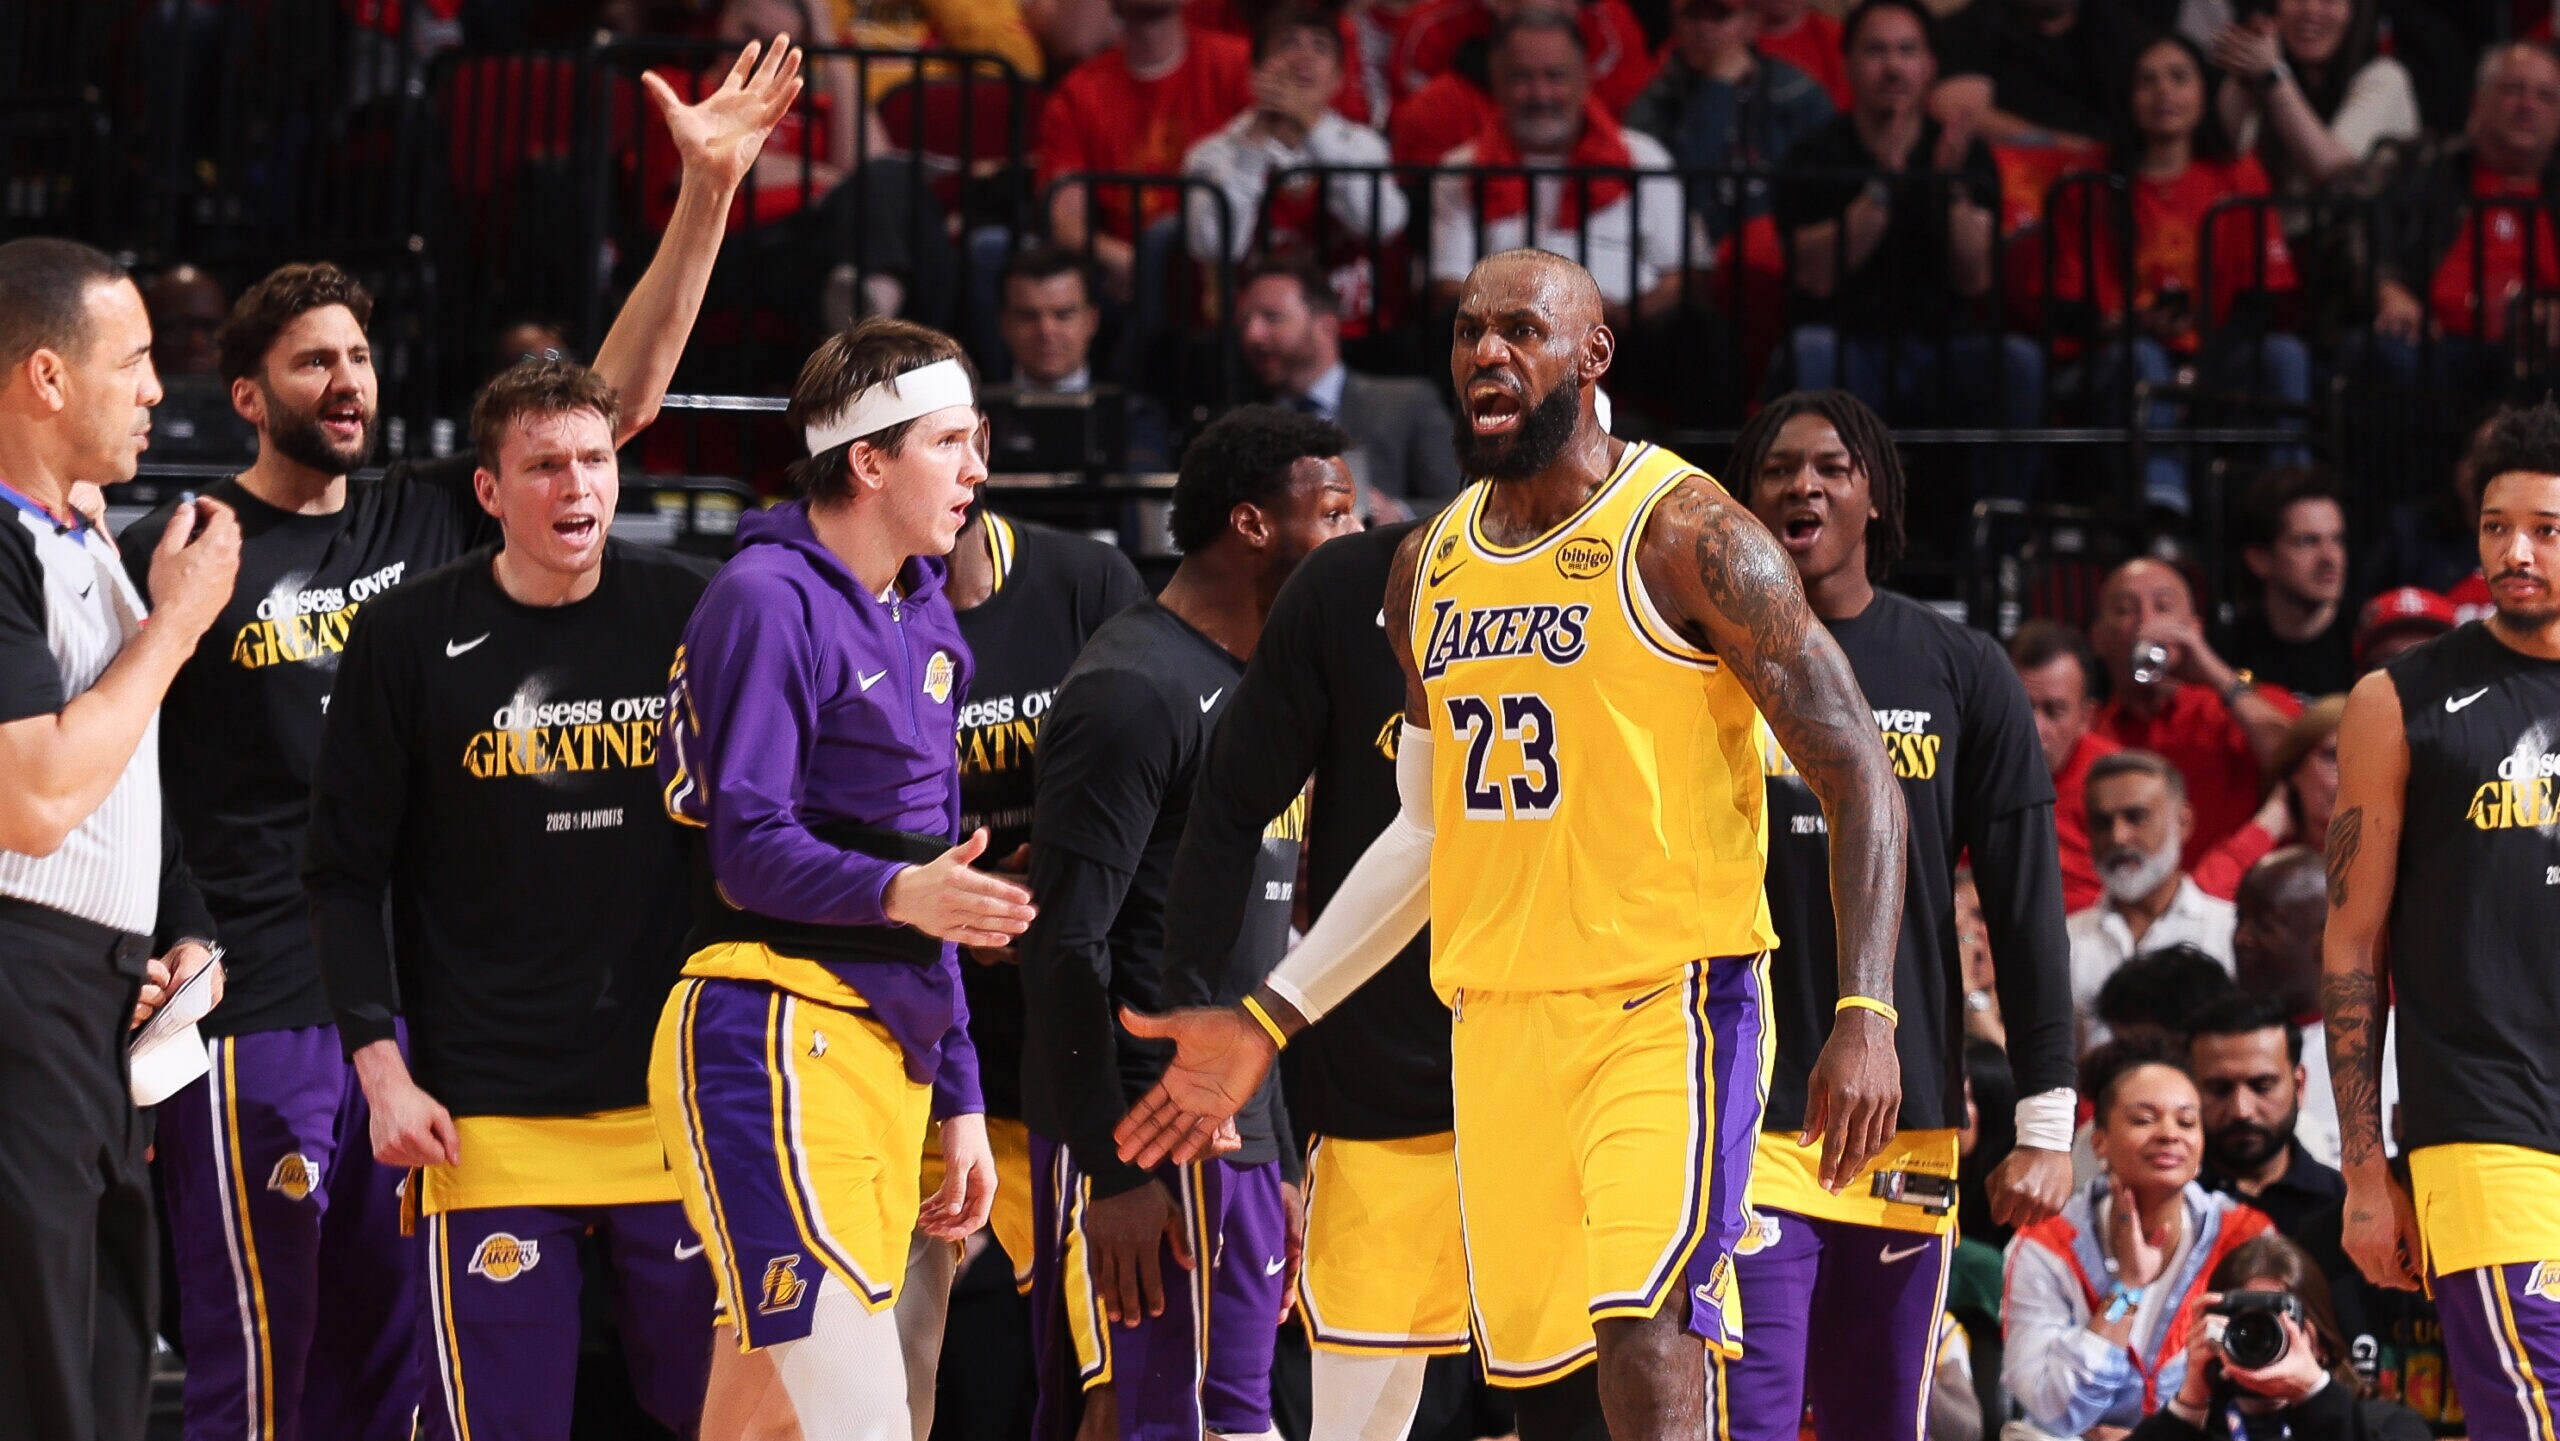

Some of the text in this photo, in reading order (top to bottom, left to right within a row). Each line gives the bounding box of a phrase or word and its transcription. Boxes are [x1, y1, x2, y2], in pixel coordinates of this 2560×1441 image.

[1562, 548, 1609, 568] bibigo
[257, 561, 405, 620] obsess over
[231, 602, 359, 669] GREAT
[1422, 597, 1592, 683] LAKERS
[493, 693, 666, 730] obsess ove
[463, 718, 662, 780] GREATNE
[1443, 692, 1562, 821] 23
[546, 808, 624, 831] 2026 PLAYOFFS
